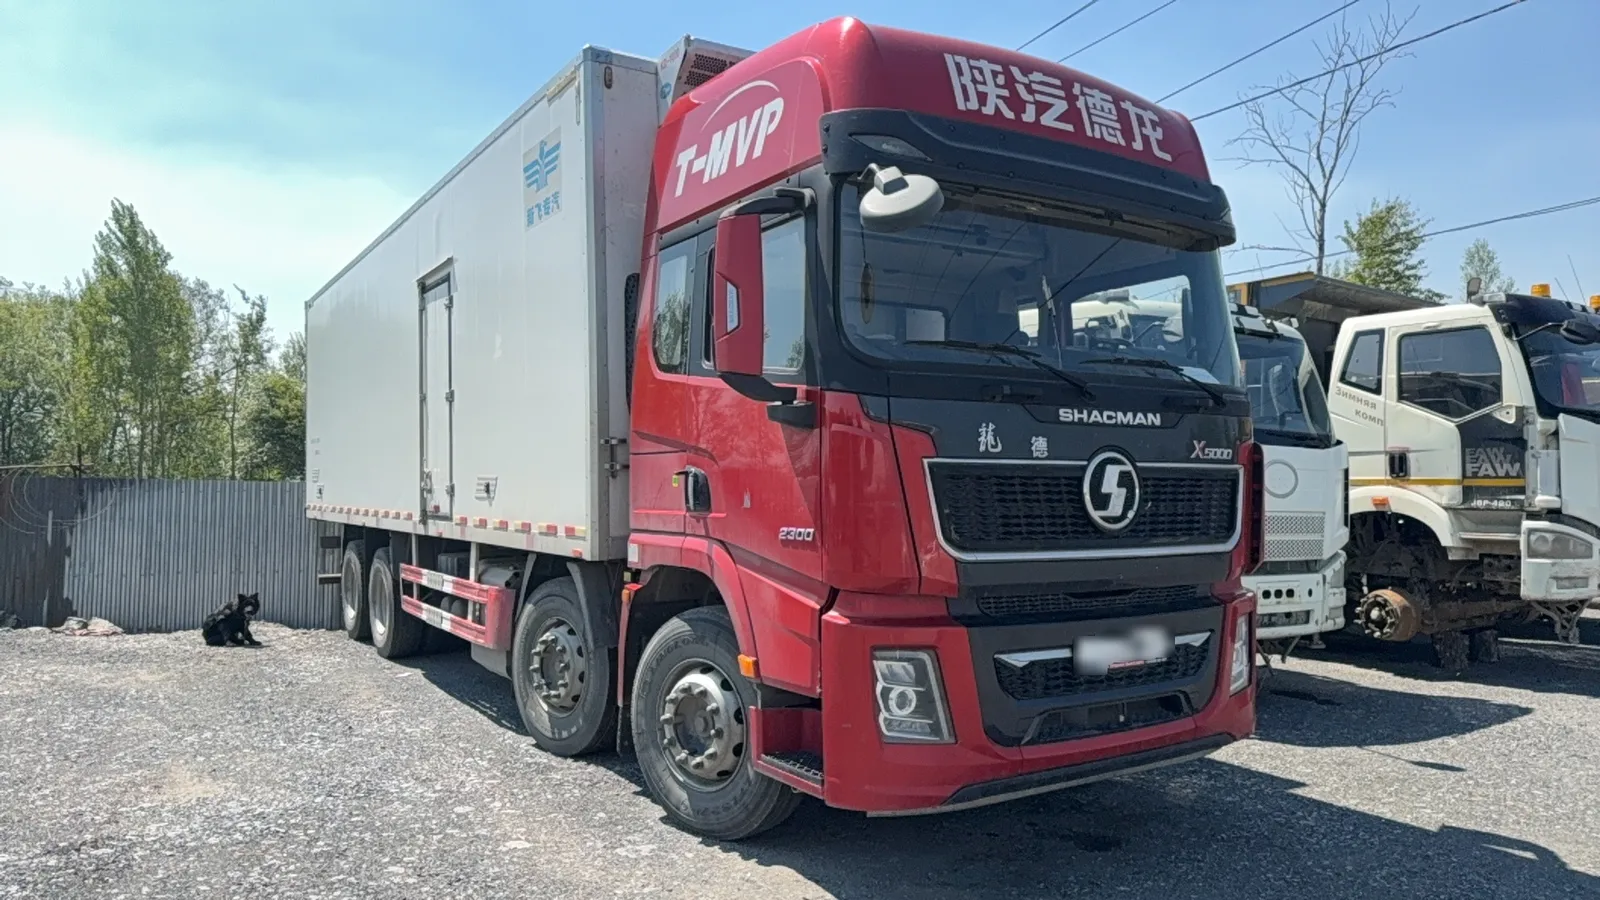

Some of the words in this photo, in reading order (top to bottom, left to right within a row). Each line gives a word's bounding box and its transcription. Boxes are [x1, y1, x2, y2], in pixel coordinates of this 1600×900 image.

[943, 52, 1174, 162] 陕汽德龙
[674, 96, 784, 198] T-MVP
[1058, 408, 1162, 426] SHACMAN
[1190, 440, 1233, 460] X5000
[1466, 462, 1520, 477] FAW
[779, 526, 815, 541] 2300
